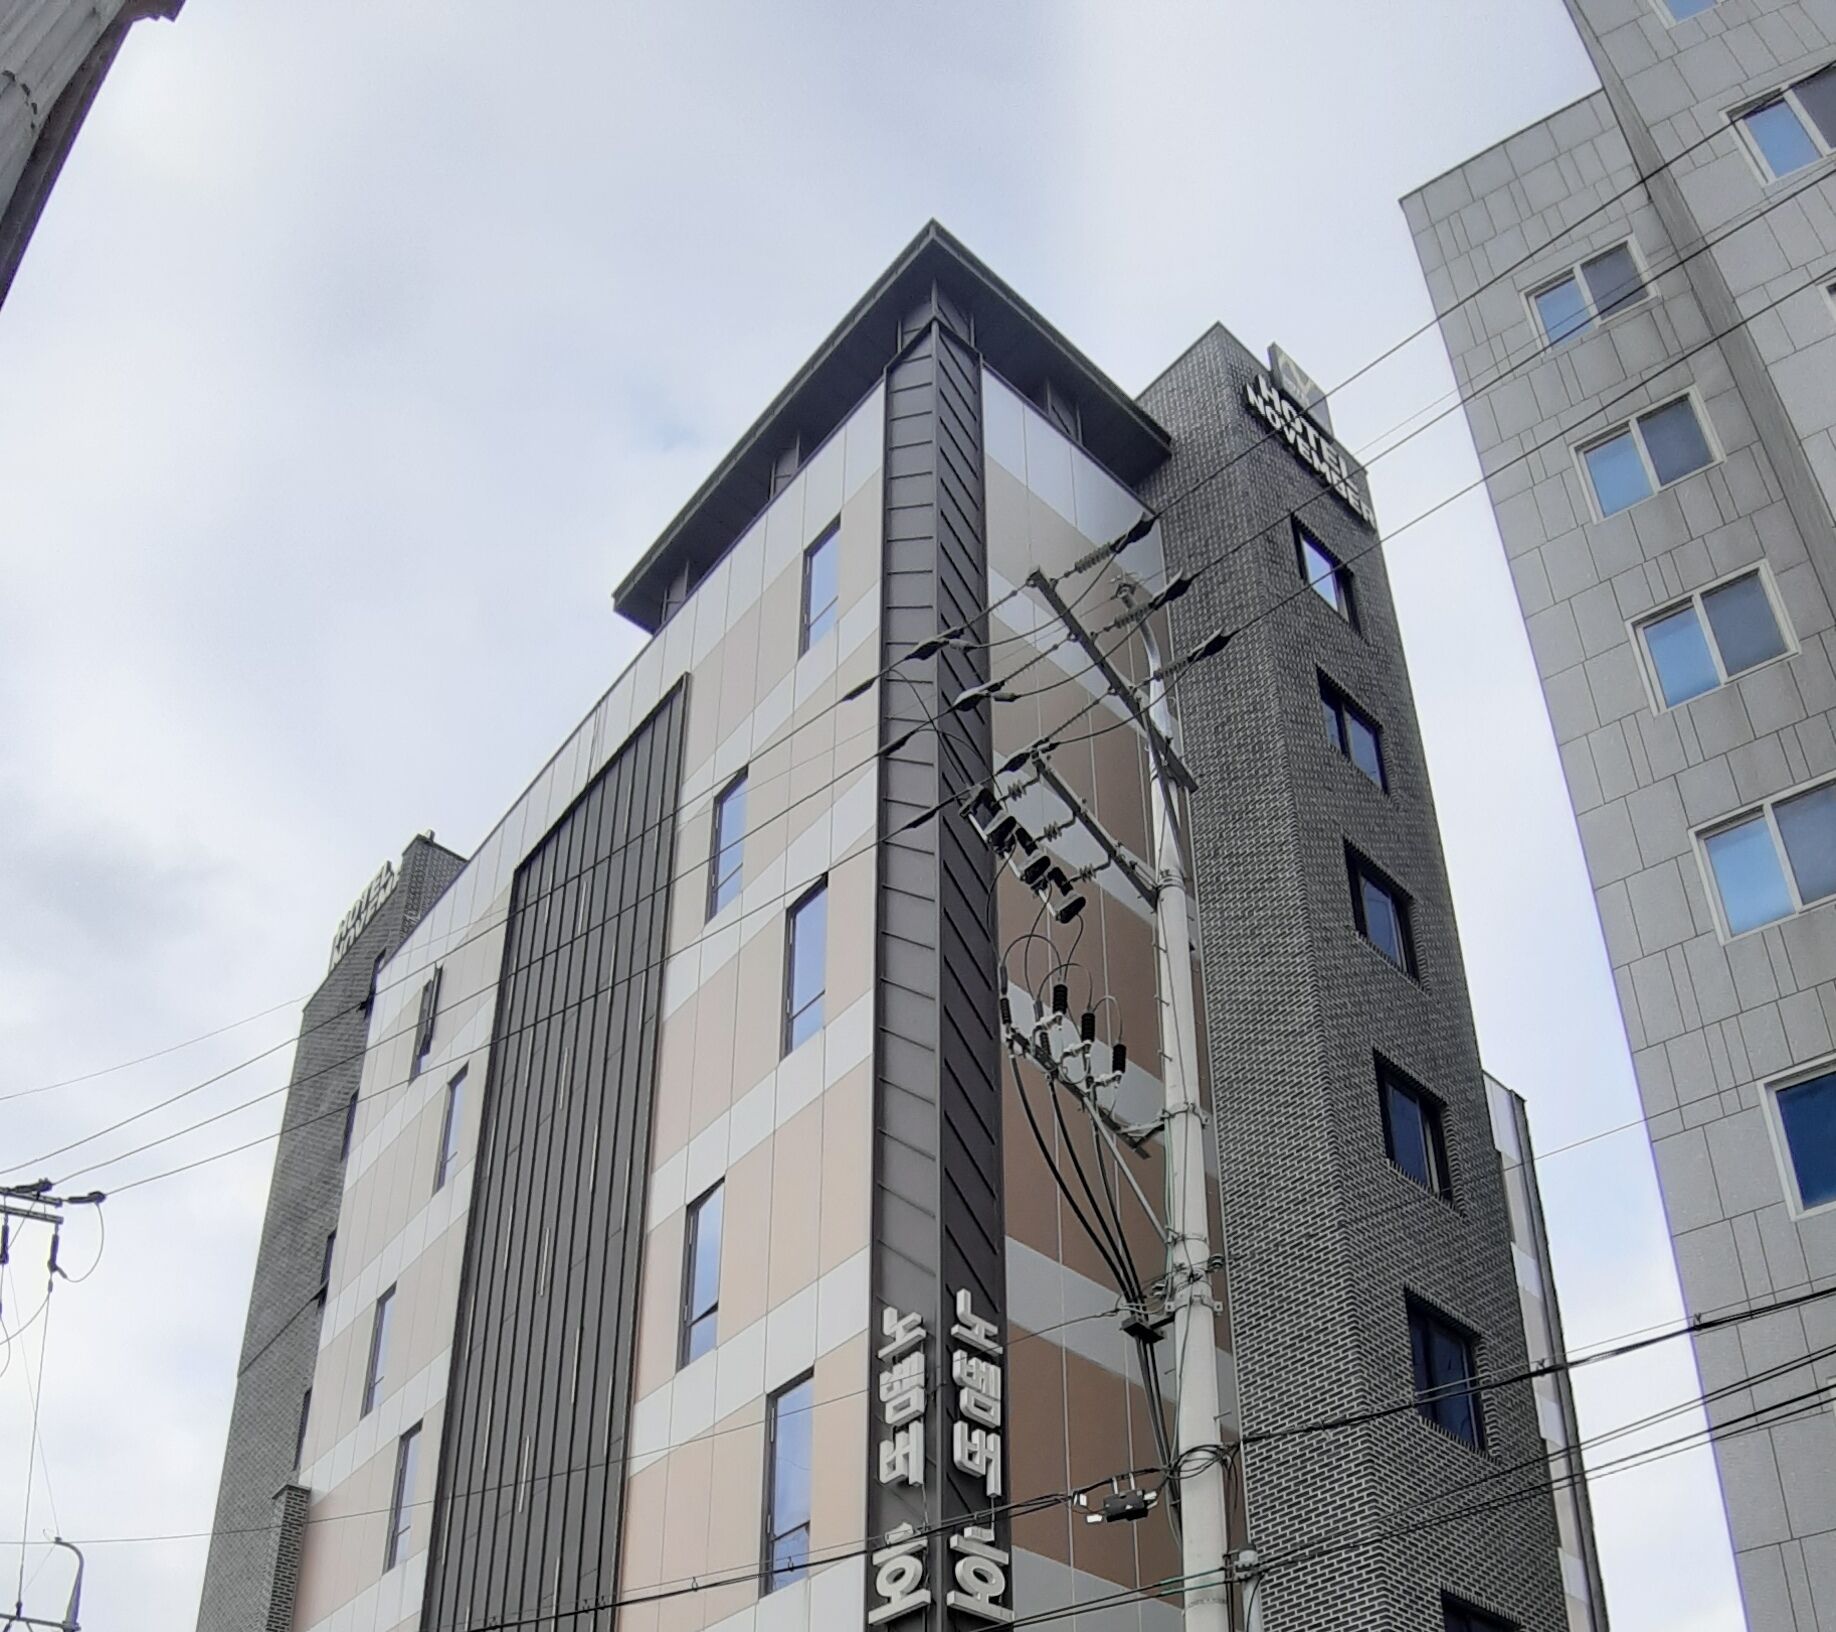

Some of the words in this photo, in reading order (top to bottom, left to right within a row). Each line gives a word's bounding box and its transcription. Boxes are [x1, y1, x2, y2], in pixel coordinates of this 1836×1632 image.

[1246, 382, 1377, 529] NOVEMBER
[1256, 373, 1359, 497] HOTEL
[878, 1305, 926, 1487] 노벰버
[951, 1288, 1003, 1498] 노벰버
